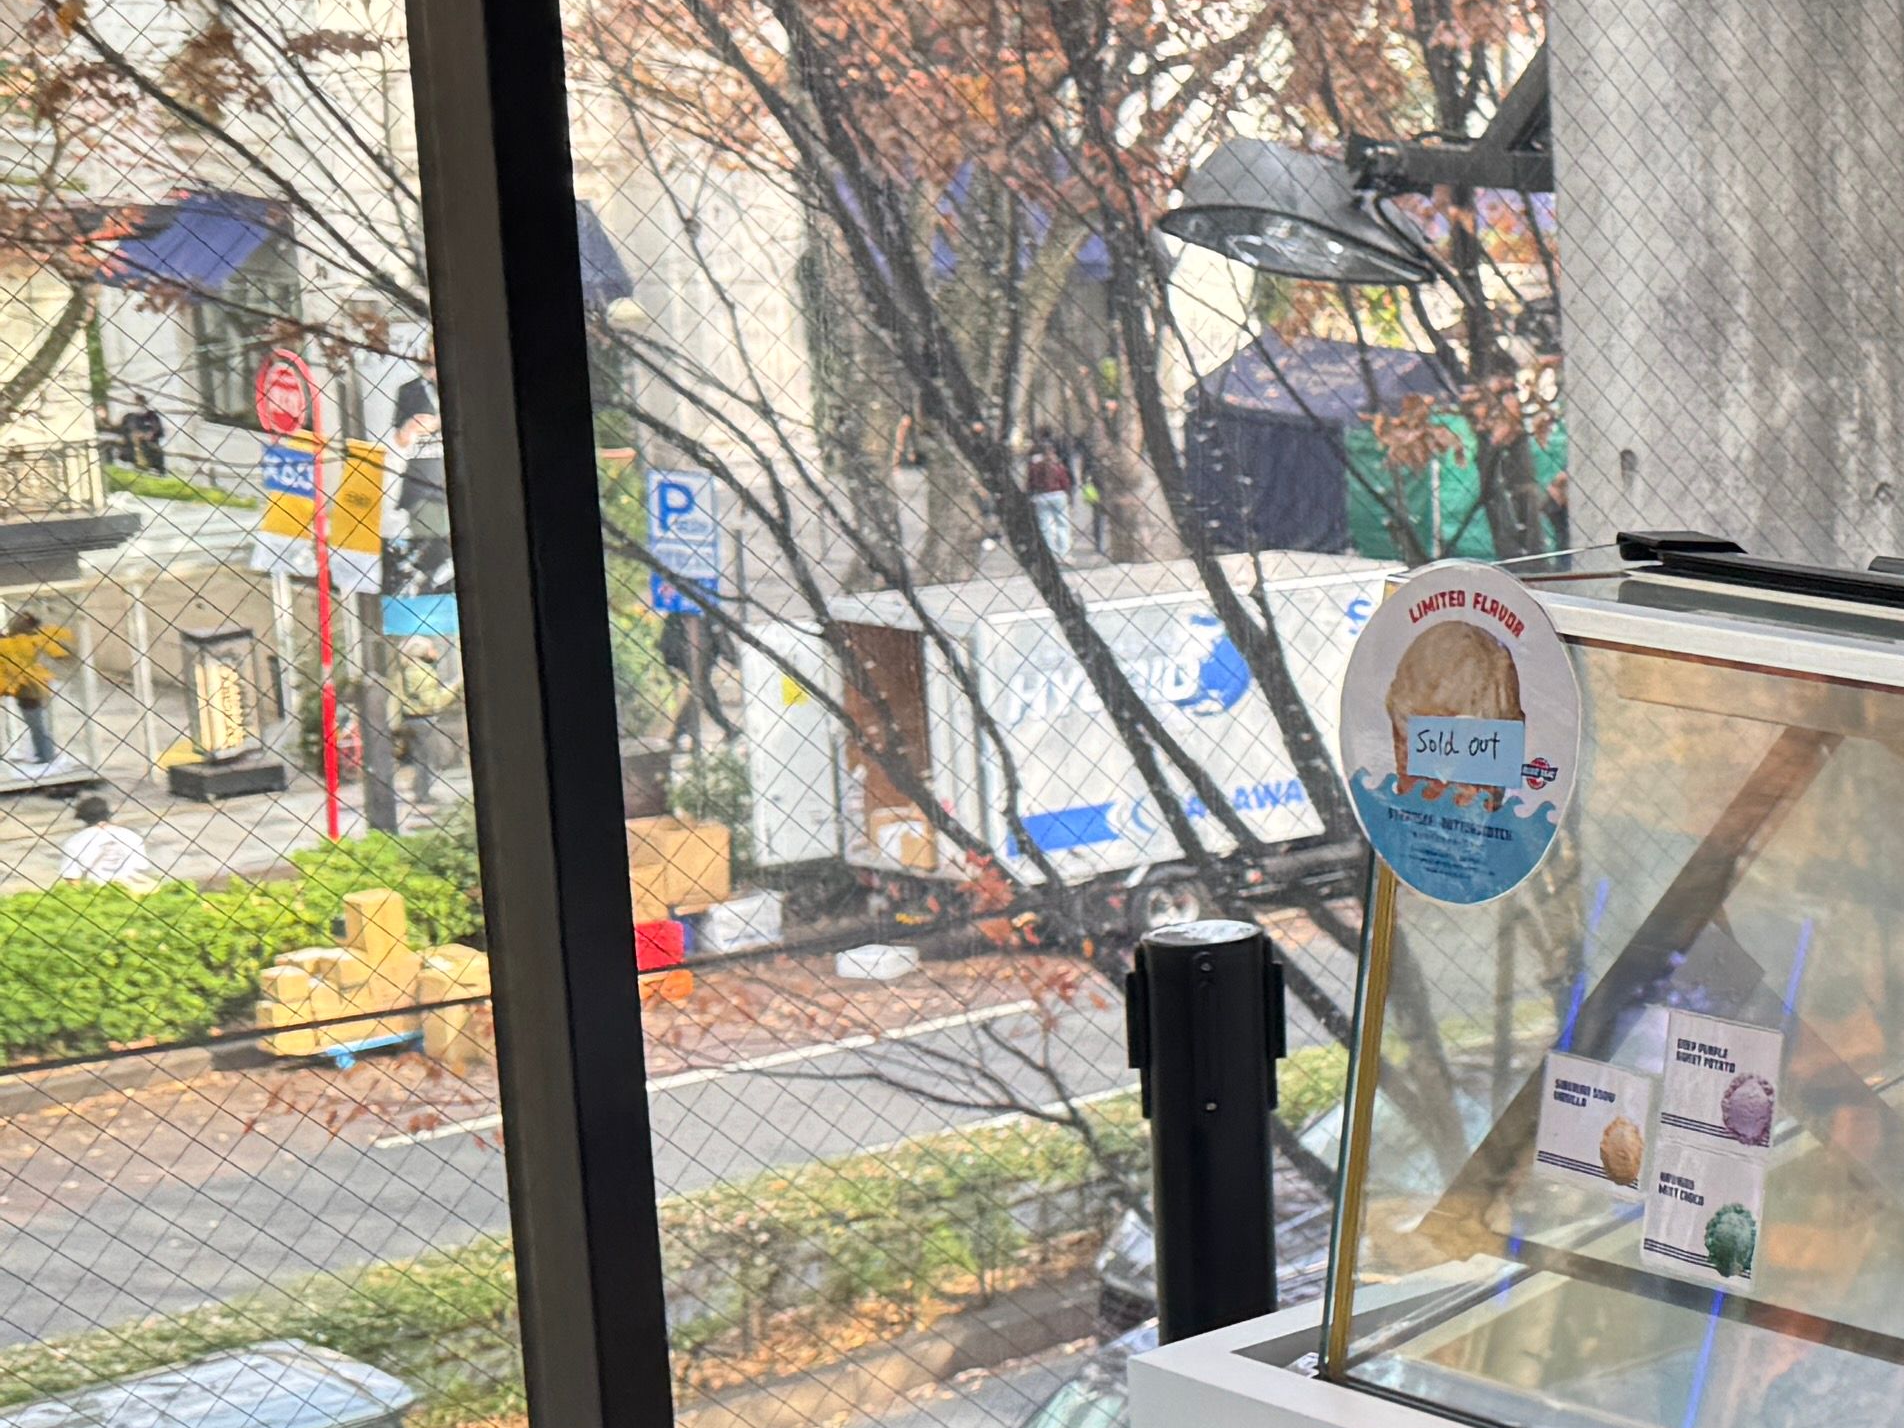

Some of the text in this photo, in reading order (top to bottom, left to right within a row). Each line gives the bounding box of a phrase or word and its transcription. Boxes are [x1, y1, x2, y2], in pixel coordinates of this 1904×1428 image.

[658, 481, 695, 532] P
[1408, 590, 1466, 624] LIMITED
[1472, 592, 1525, 638] FLAVOR
[1415, 729, 1501, 760] Sold out
